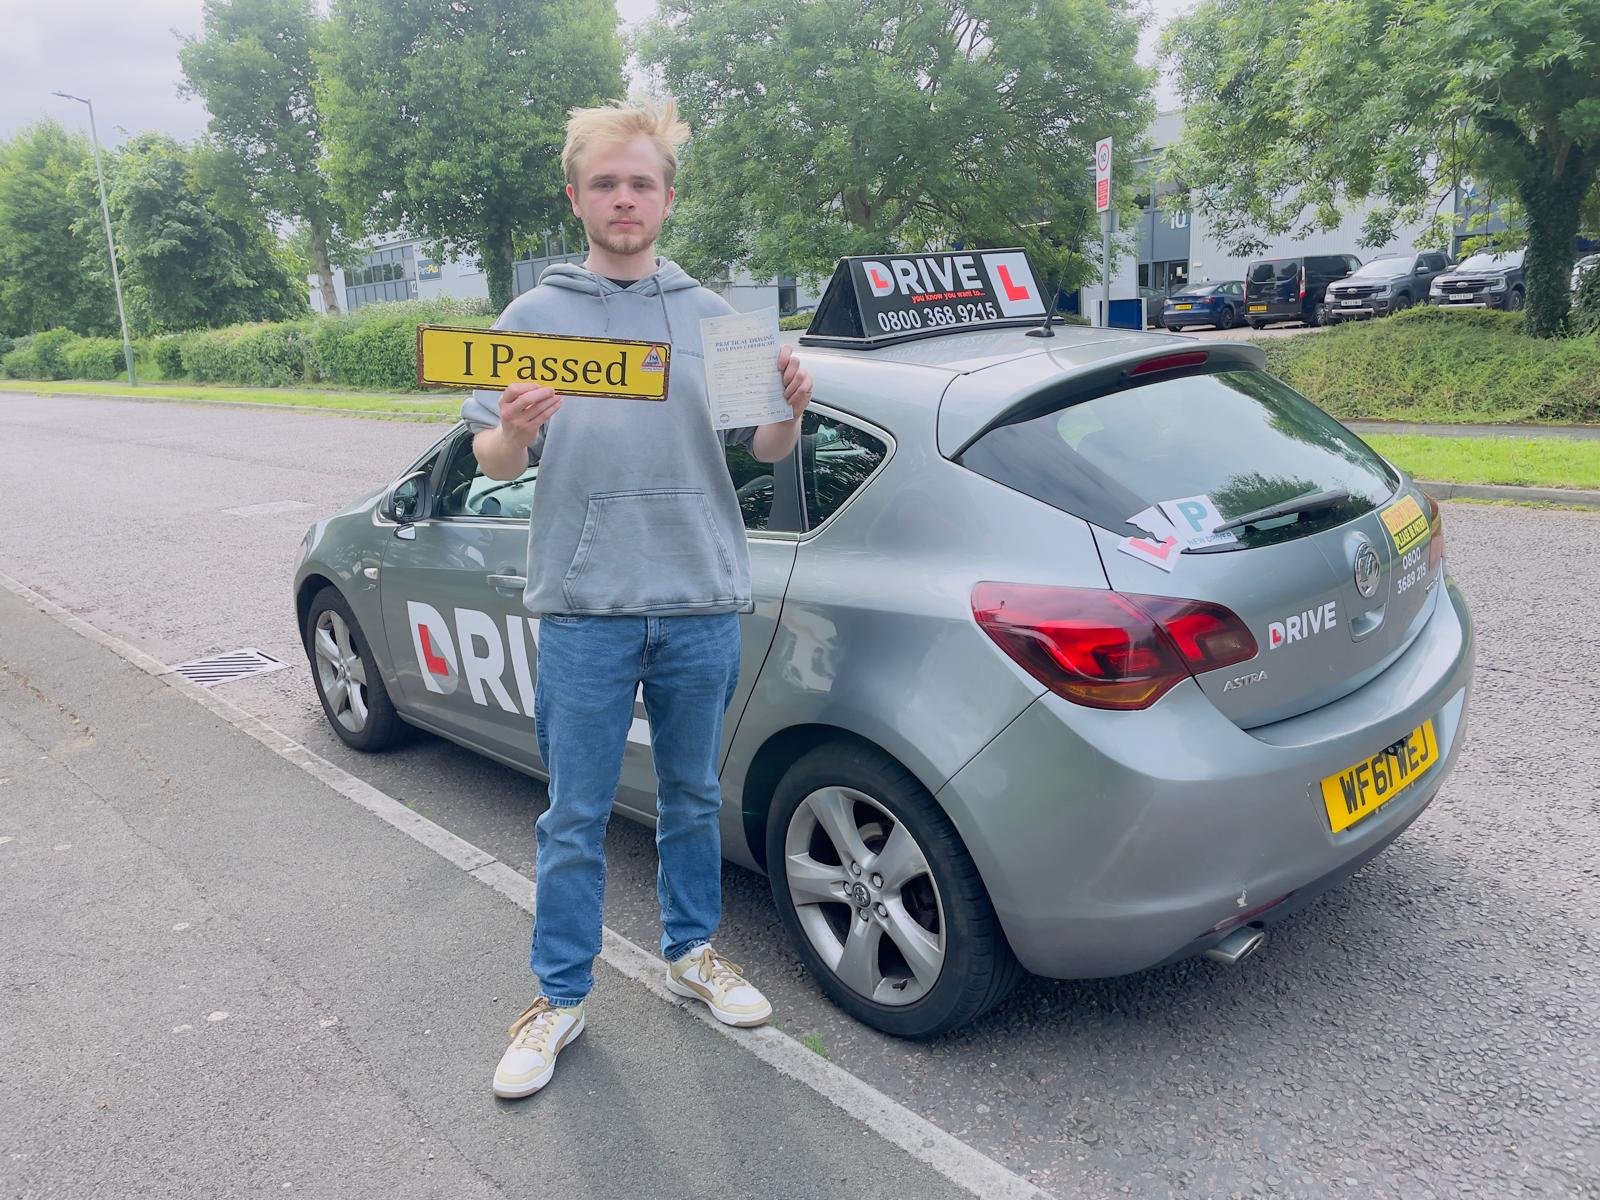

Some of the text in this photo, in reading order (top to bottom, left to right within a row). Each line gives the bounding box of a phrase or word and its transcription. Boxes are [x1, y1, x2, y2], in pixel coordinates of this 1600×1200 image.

[862, 255, 984, 297] DRIVE
[996, 264, 1030, 301] L
[911, 294, 925, 304] you
[925, 293, 943, 301] know
[943, 292, 957, 300] you
[877, 302, 998, 332] 0800 368 9215
[715, 335, 775, 348] PRACTICAL DRIVING
[463, 341, 628, 386] I Passed
[1176, 501, 1208, 532] P
[1402, 547, 1421, 570] 0800
[1397, 571, 1415, 594] 3689
[1416, 562, 1427, 581] 215
[1268, 600, 1337, 650] DRIVE
[1223, 670, 1269, 692] ASTRA
[1338, 753, 1394, 814] WF61
